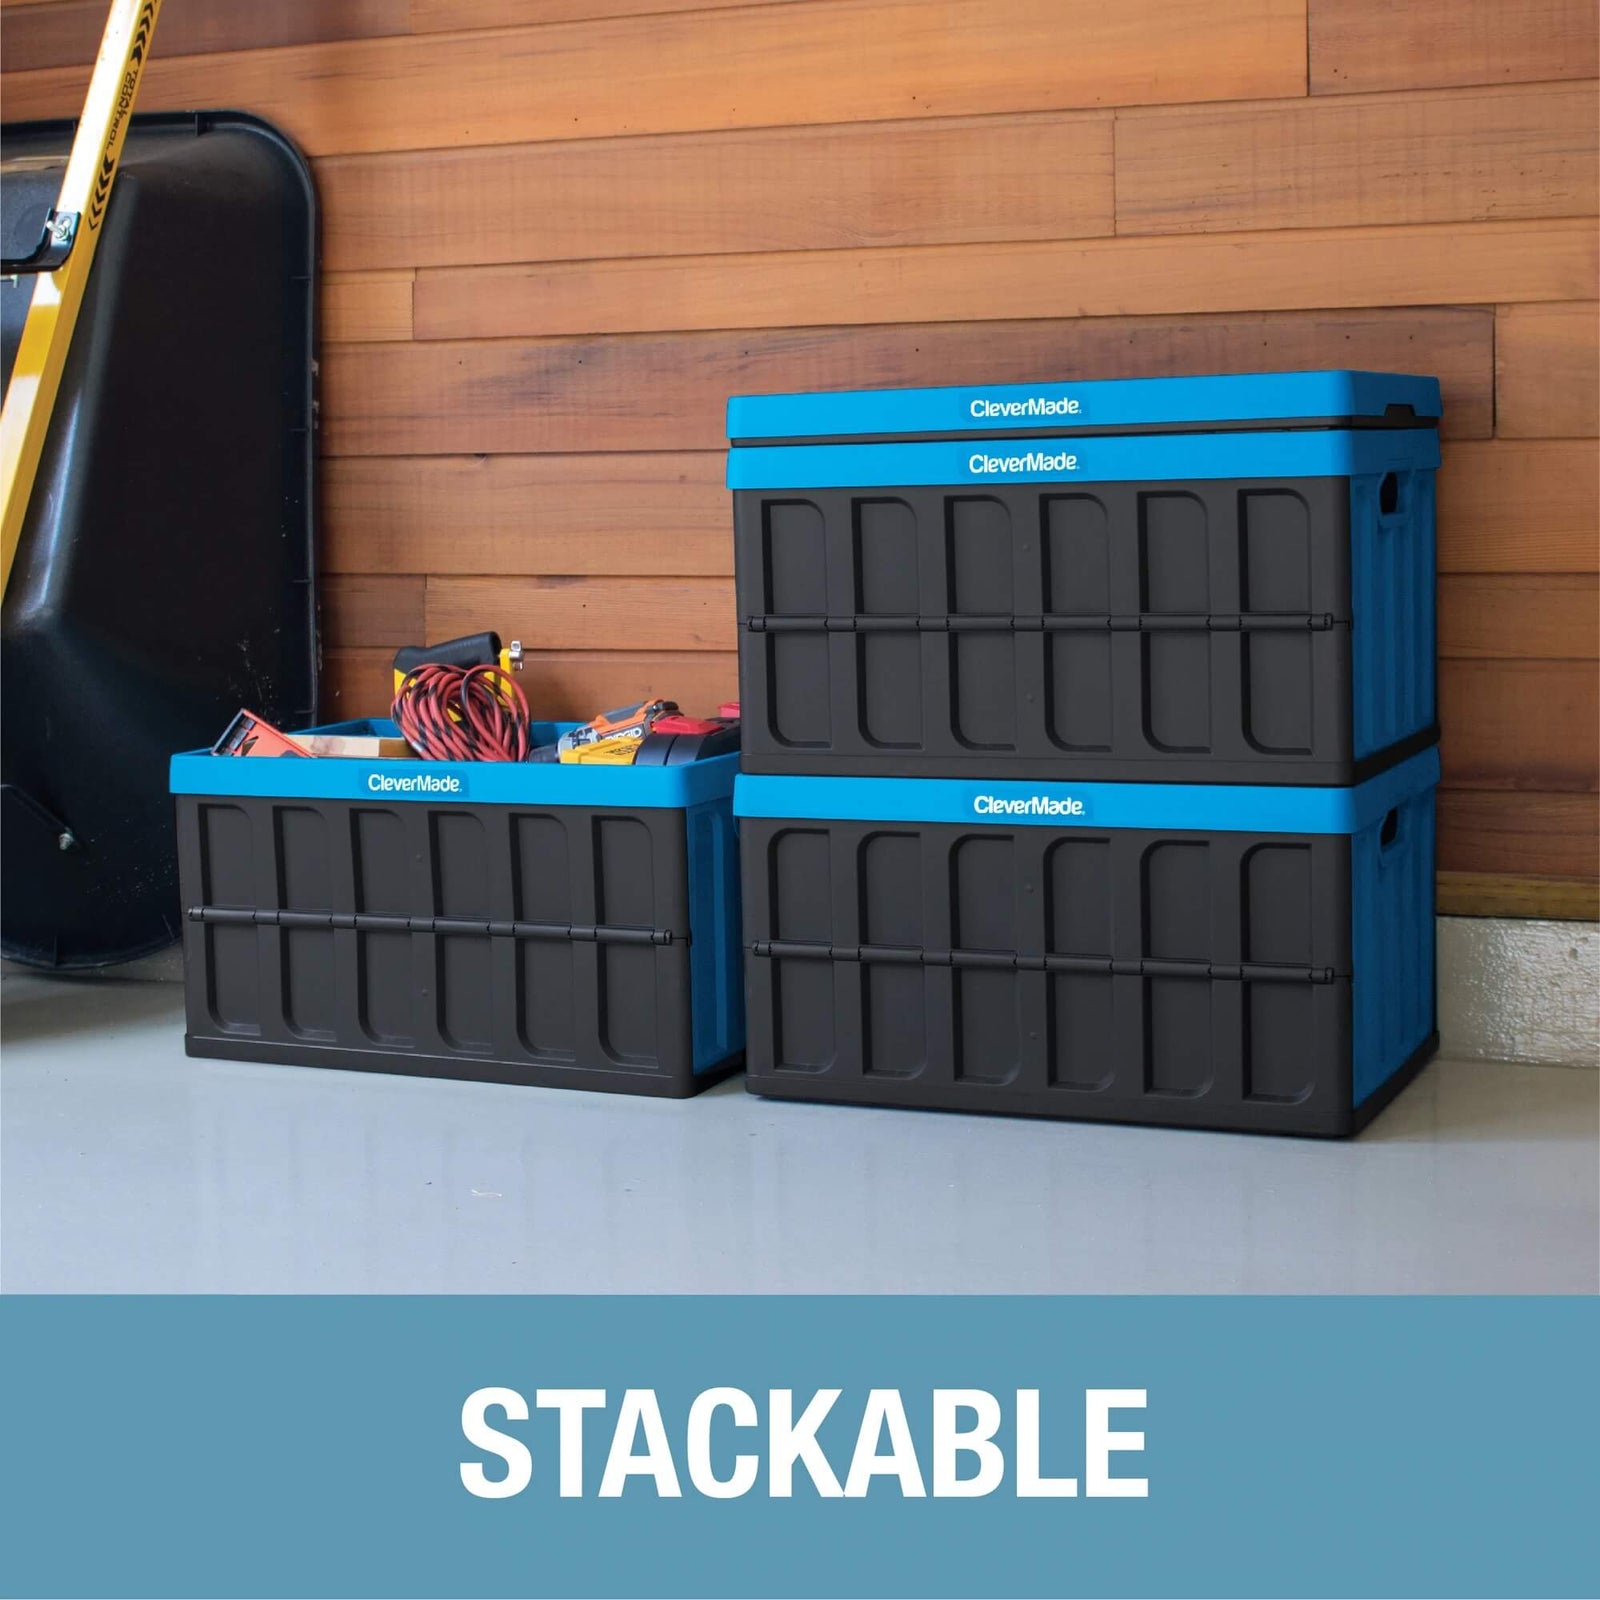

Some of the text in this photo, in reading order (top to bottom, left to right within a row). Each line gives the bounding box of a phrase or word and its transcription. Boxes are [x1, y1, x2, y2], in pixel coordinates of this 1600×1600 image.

[119, 69, 138, 118] TOTAL
[106, 71, 132, 150] CONTROL
[969, 397, 1080, 418] CleverMade
[968, 452, 1078, 474] CleverMade
[367, 773, 461, 793] CleverMade
[973, 795, 1084, 816] CleverMade
